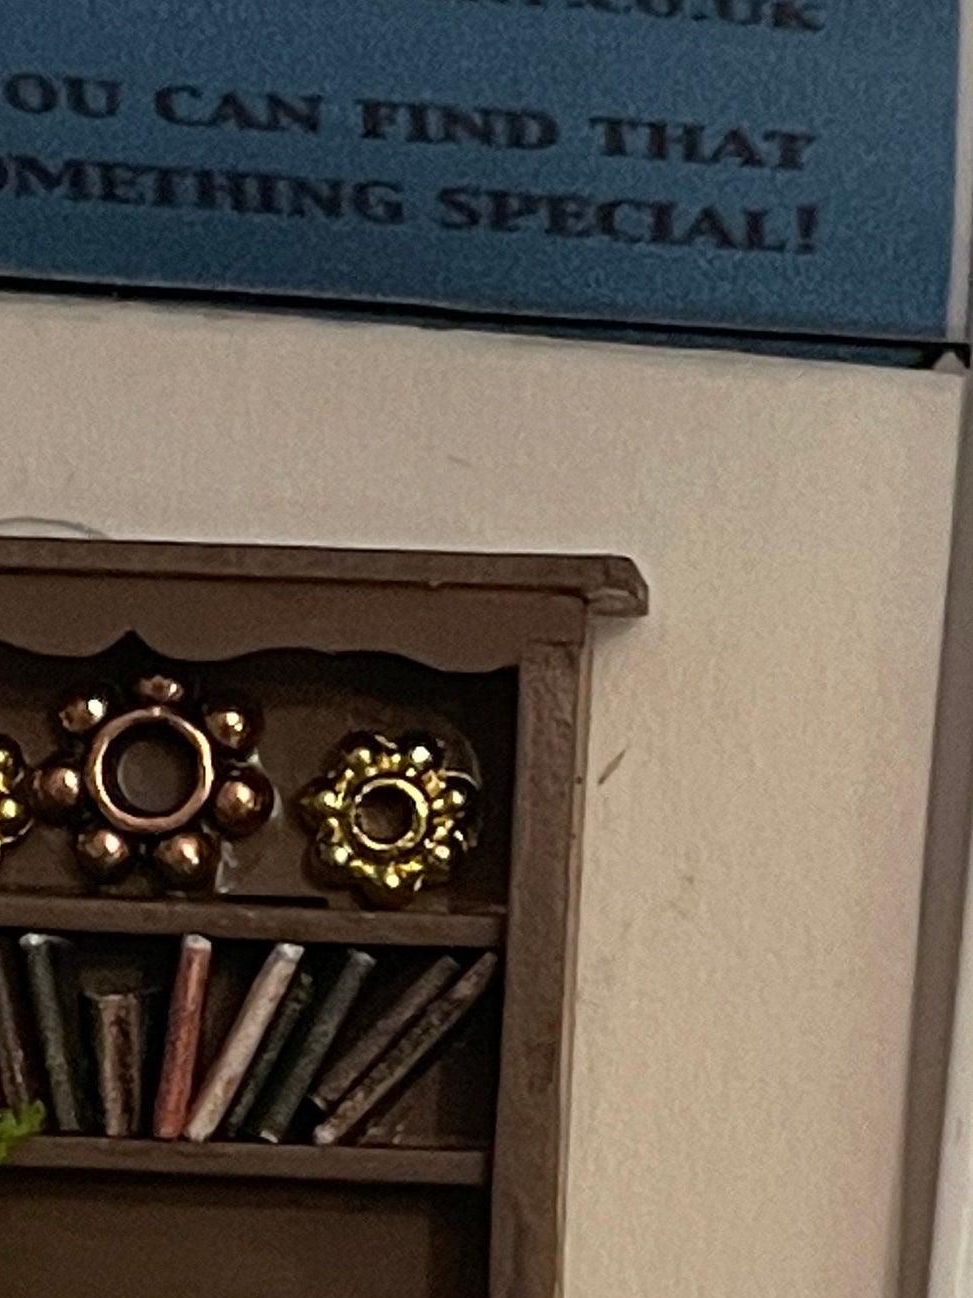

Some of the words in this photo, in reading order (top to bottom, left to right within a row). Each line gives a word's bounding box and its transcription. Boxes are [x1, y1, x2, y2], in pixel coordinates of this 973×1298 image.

[154, 85, 322, 133] CAN
[355, 101, 560, 151] FIND
[588, 117, 817, 170] THAT
[435, 185, 819, 255] SPECIAL!
